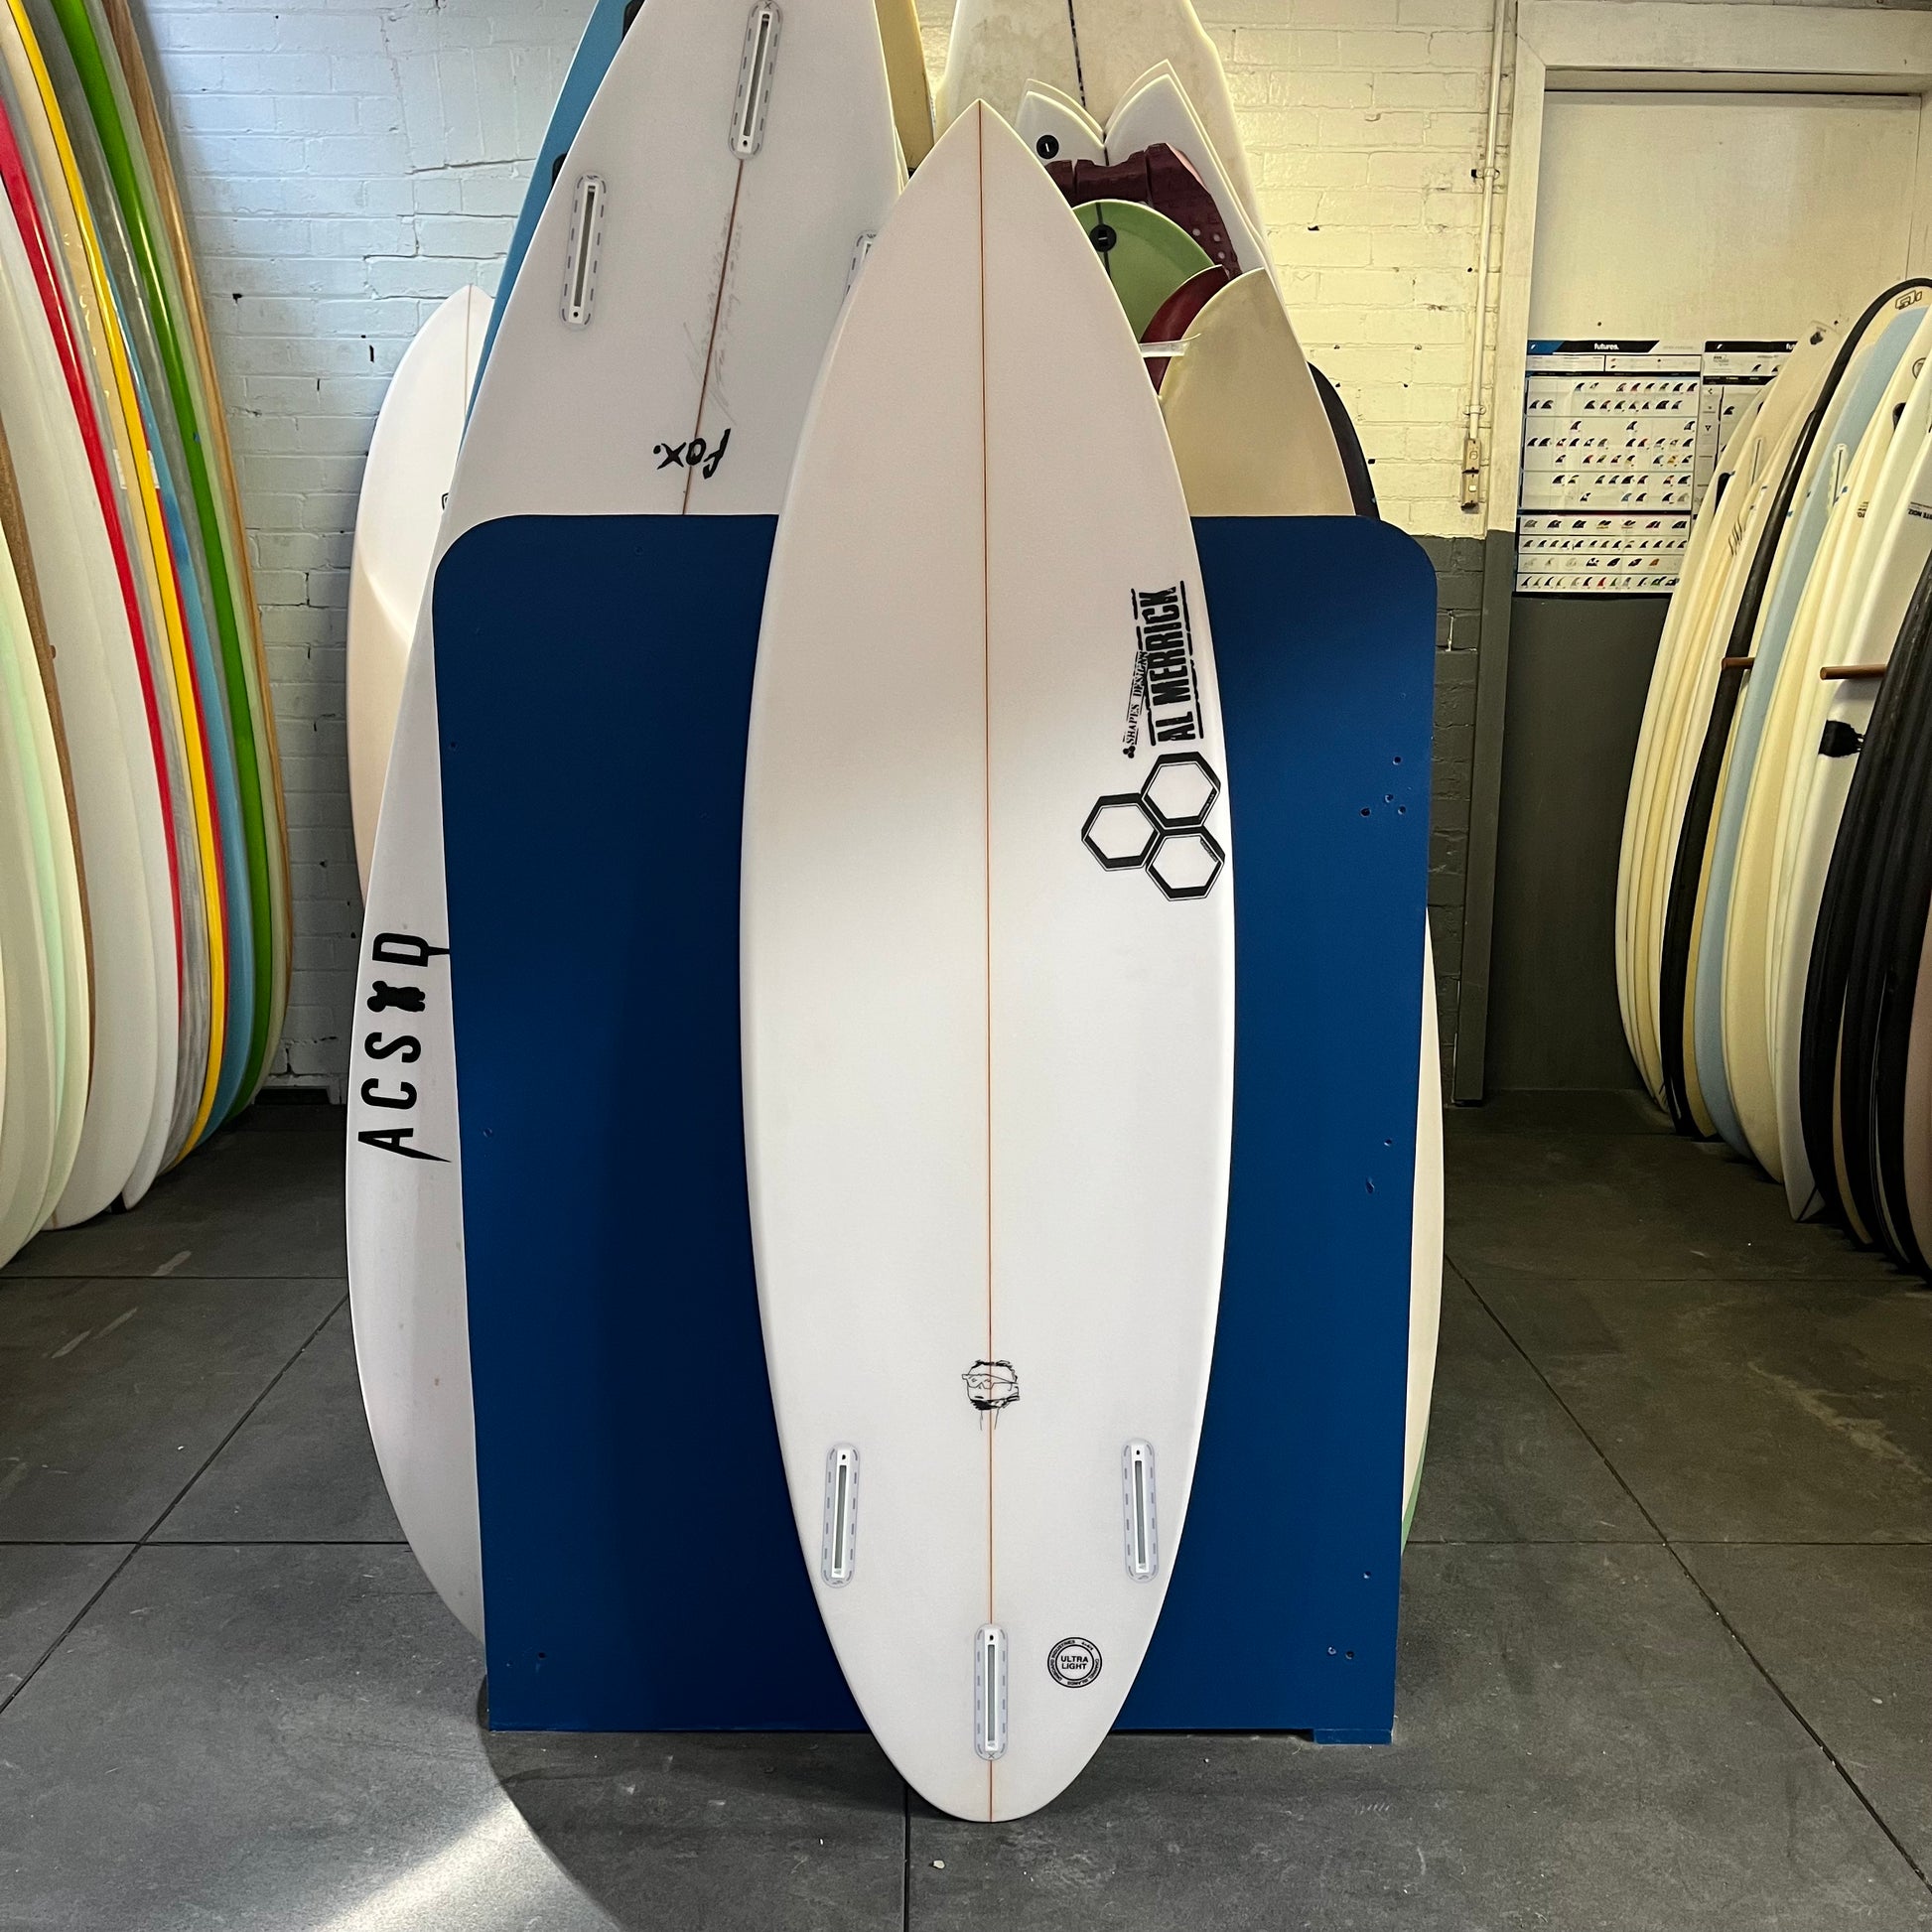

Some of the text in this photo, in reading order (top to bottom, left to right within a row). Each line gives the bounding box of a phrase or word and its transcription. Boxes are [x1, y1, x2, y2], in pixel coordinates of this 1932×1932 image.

[1139, 586, 1195, 742] AL MERRICK
[1126, 704, 1140, 745] SHAPES
